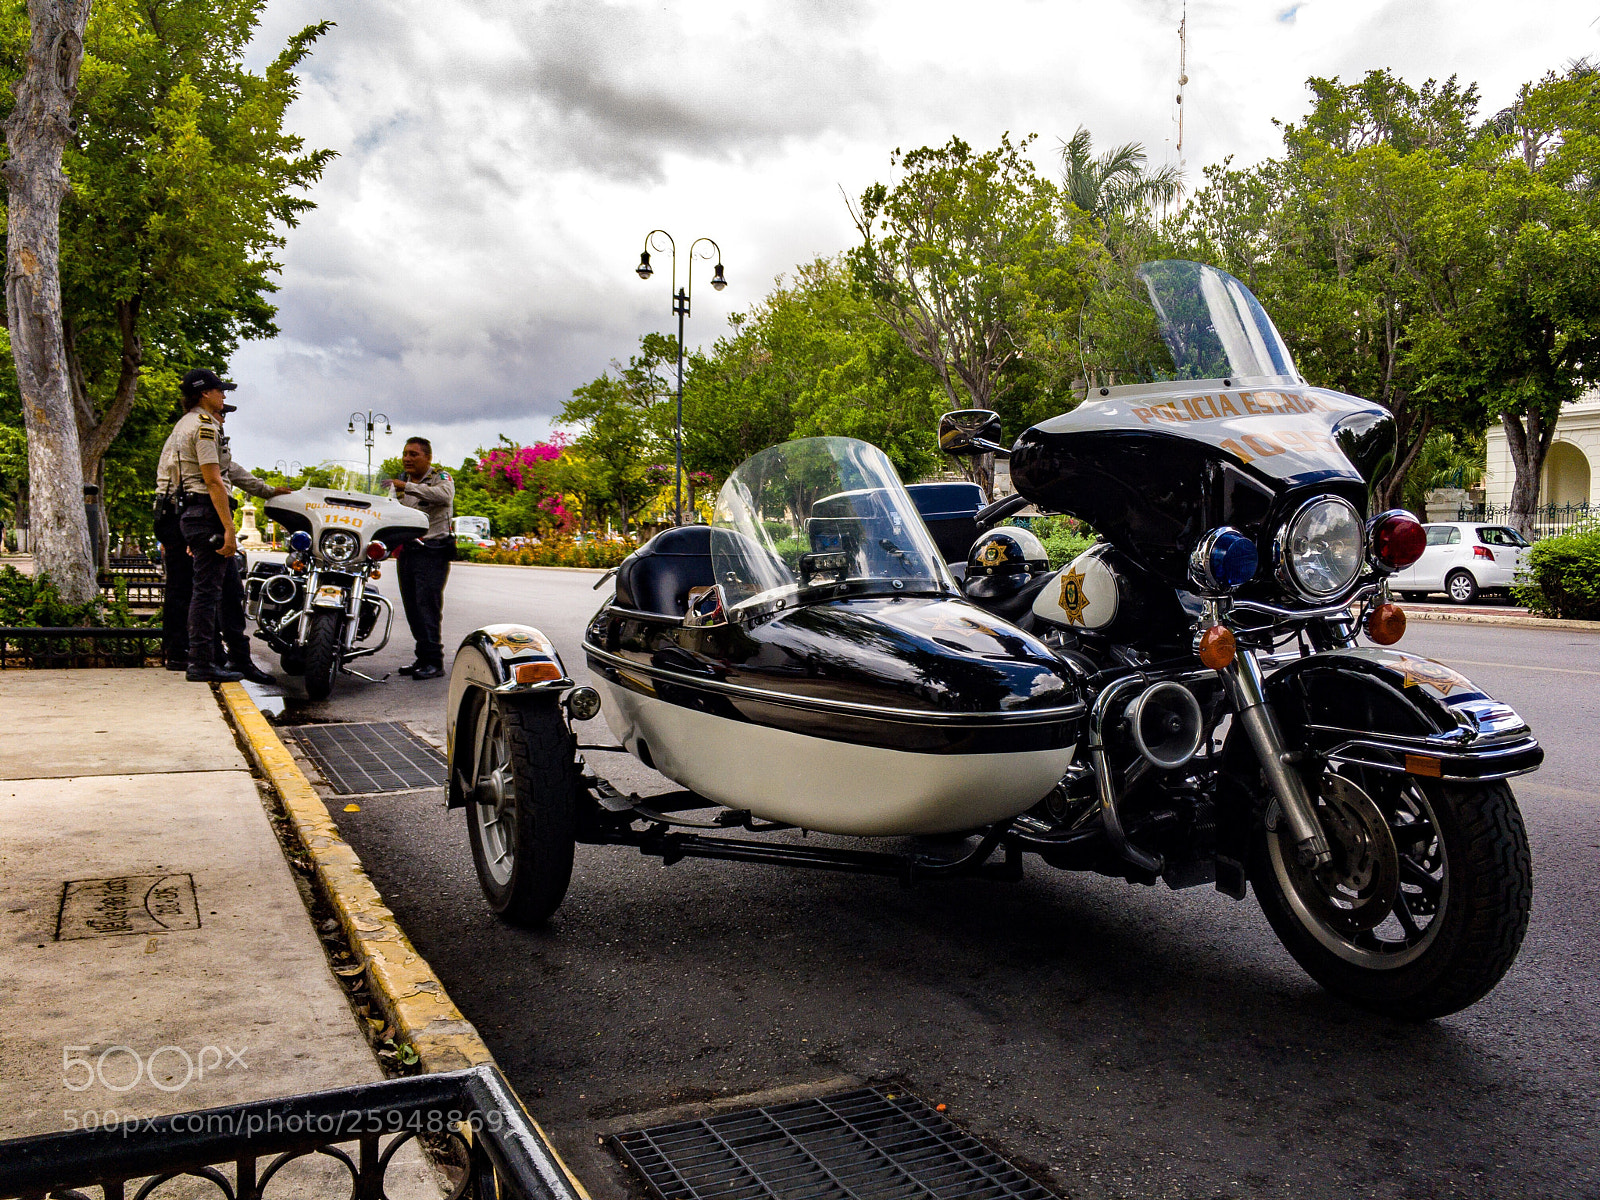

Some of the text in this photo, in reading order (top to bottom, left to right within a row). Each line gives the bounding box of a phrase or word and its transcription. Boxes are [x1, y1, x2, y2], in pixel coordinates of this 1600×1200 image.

[1131, 391, 1339, 424] POLICIA ESTATAL
[1220, 430, 1340, 464] 1095
[325, 514, 363, 528] 1140
